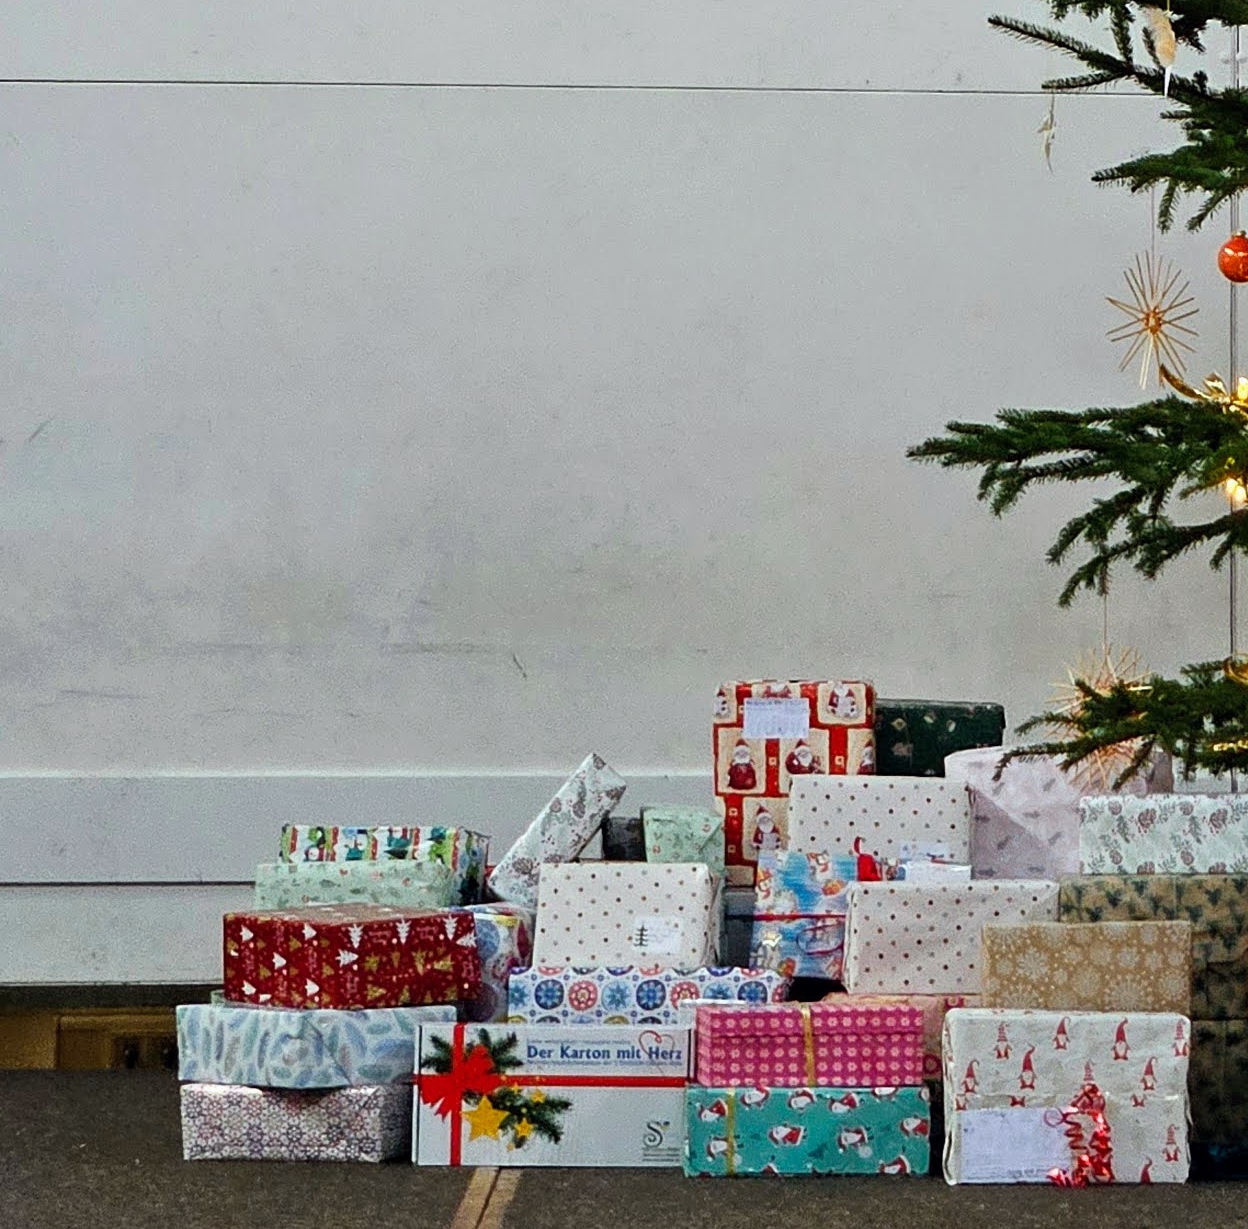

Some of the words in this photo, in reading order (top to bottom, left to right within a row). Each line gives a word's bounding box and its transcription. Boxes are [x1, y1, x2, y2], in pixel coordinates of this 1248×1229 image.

[526, 1045, 553, 1059] Der
[560, 1043, 611, 1060] Karton
[616, 1045, 642, 1060] mit
[648, 1045, 683, 1060] Herz
